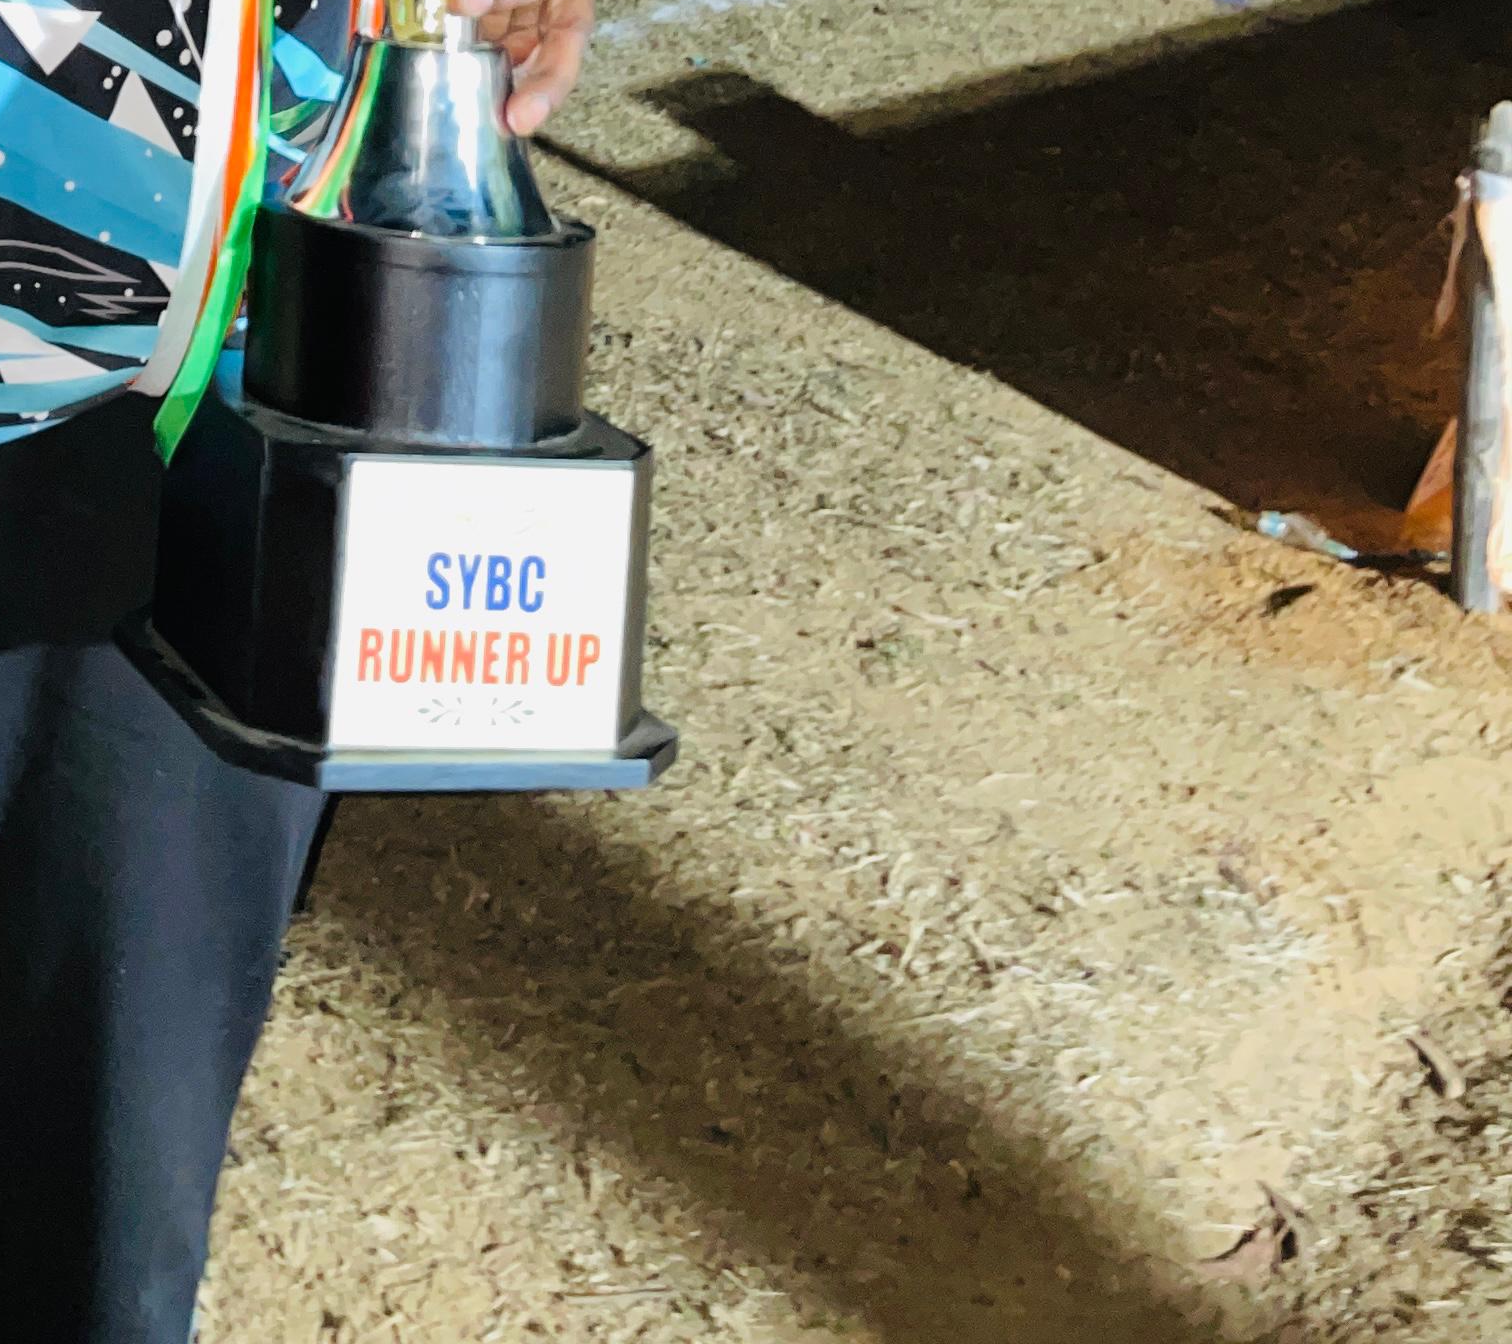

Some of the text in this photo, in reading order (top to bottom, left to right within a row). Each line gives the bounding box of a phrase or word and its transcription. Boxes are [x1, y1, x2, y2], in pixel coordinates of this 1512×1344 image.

[425, 552, 546, 613] SYBC
[357, 628, 601, 687] RUNNER UP
